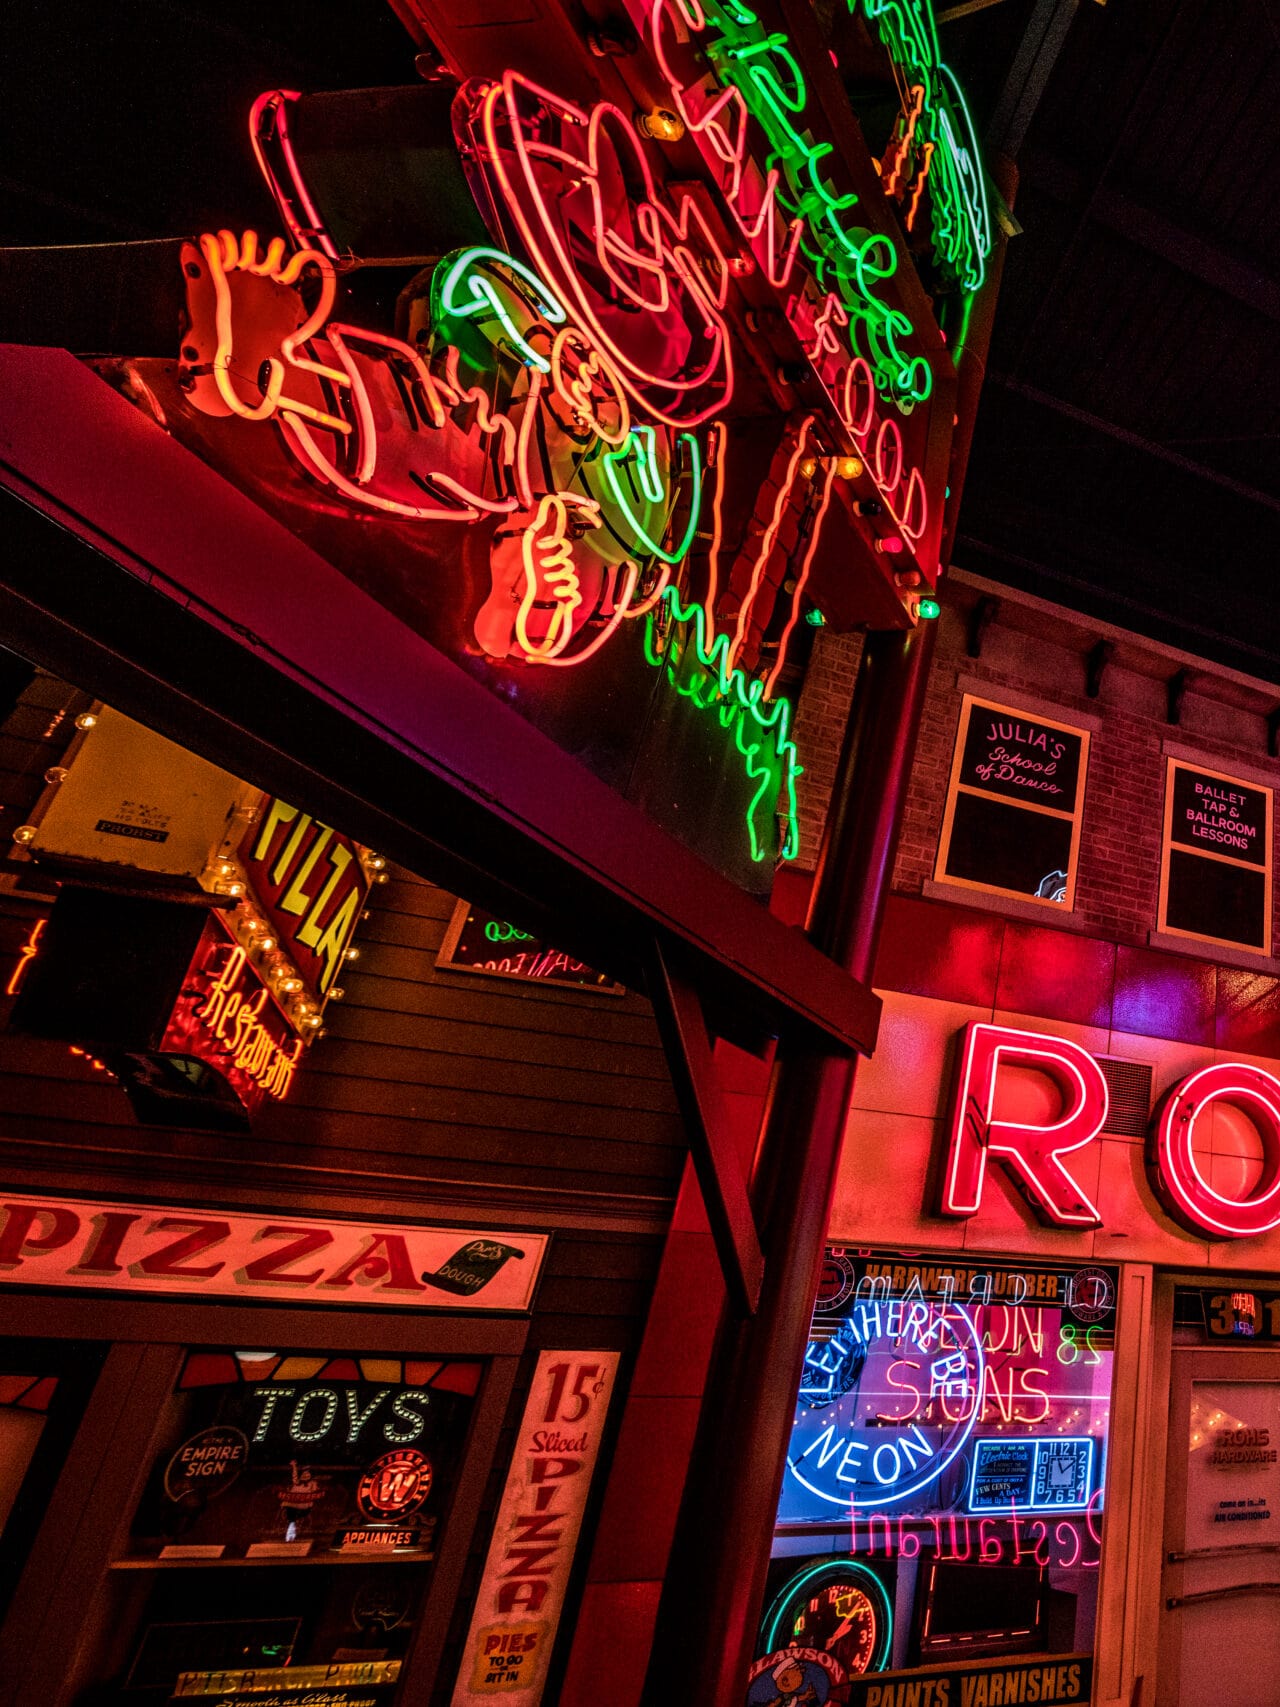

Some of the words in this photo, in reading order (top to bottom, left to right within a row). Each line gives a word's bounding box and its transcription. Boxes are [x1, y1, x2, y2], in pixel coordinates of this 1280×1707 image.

[986, 723, 1066, 760] JULIA'S
[988, 746, 1057, 776] School
[975, 762, 996, 781] of
[994, 764, 1064, 794] Dance
[1195, 782, 1246, 806] BALLET
[1202, 798, 1227, 813] TAP
[1229, 807, 1240, 818] &
[1186, 808, 1256, 838] BALLROOM
[99, 822, 164, 841] PROBST
[1192, 824, 1248, 850] LESSONS
[254, 798, 360, 995] PIZZA
[0, 1202, 428, 1294] PIZZA
[438, 1265, 485, 1287] DOUGH
[983, 1270, 1059, 1299] LUMBER
[877, 1360, 1050, 1424] SIGNS
[252, 1387, 430, 1443] TOYS
[528, 1430, 589, 1453] Sliced
[1220, 1428, 1270, 1448] ROHS
[180, 1445, 241, 1462] EMPIRE
[802, 1423, 934, 1485] NEON
[1049, 1442, 1057, 1455] 11
[1060, 1442, 1070, 1455] 12
[1073, 1442, 1077, 1455] 1
[981, 1450, 1012, 1466] Electric
[1012, 1451, 1028, 1461] Clock
[1038, 1451, 1049, 1465] 10
[1079, 1451, 1087, 1464] 2
[1212, 1450, 1278, 1465] HARDWARE
[185, 1461, 228, 1477] SIGN
[1038, 1467, 1046, 1479] 9
[1077, 1466, 1085, 1479] 3
[975, 1484, 990, 1496] FEW
[991, 1482, 1011, 1491] CENTS
[1006, 1487, 1021, 1497] DAY
[1037, 1481, 1045, 1495] 8
[1076, 1480, 1085, 1493] 4
[1045, 1490, 1053, 1504] 7
[1056, 1490, 1064, 1503] 6
[1067, 1490, 1076, 1503] 5
[1214, 1514, 1226, 1523] AIR
[1227, 1510, 1271, 1522] CONDITIONED
[341, 1531, 413, 1545] APPLIANCES
[496, 1456, 582, 1615] PIZZA
[829, 1589, 838, 1604] 12
[810, 1598, 820, 1613] 11
[483, 1632, 538, 1656] PIES
[859, 1630, 868, 1645] 3
[488, 1655, 505, 1666] TO
[506, 1654, 524, 1666] GO
[852, 1653, 862, 1668] 4
[484, 1672, 505, 1684] SIT
[505, 1670, 519, 1682] IN
[866, 1678, 950, 1707] PAINTS
[960, 1664, 1081, 1707] VARNISHES
[300, 1692, 348, 1705] Glass
